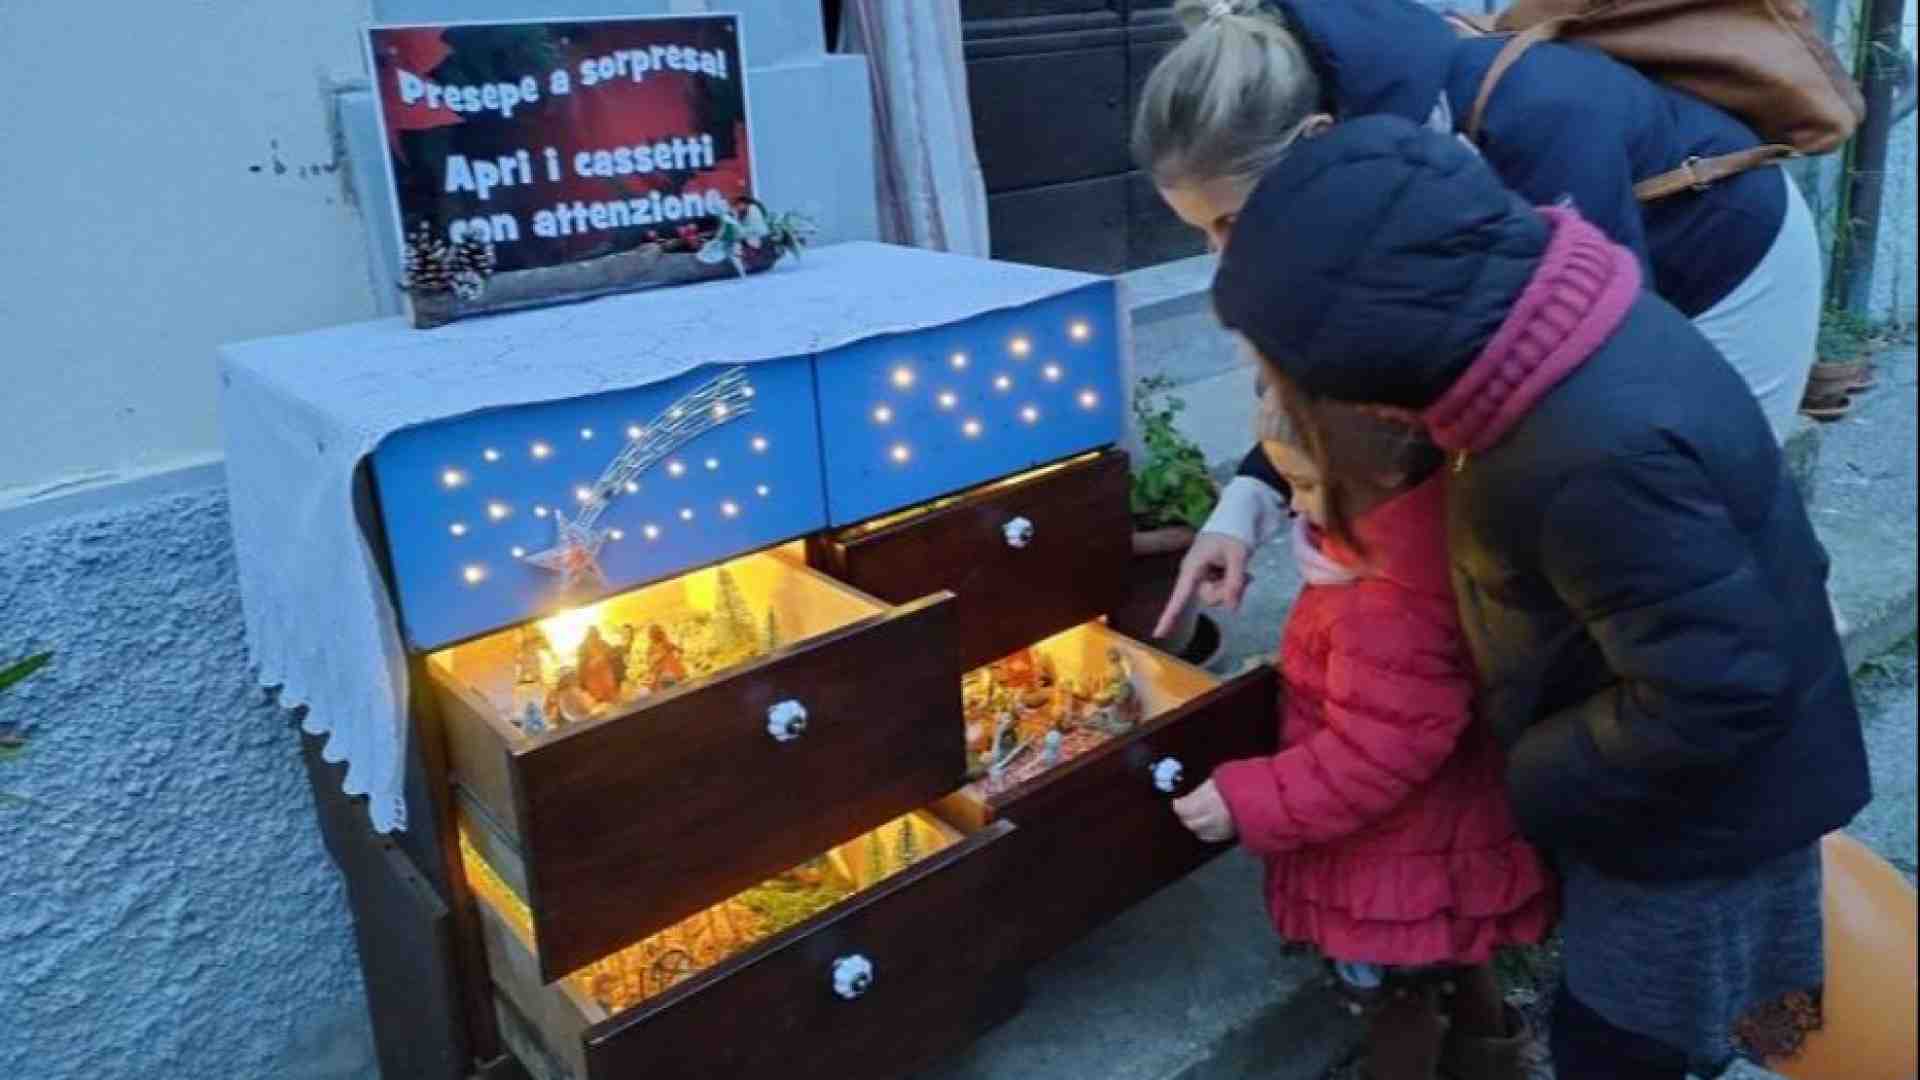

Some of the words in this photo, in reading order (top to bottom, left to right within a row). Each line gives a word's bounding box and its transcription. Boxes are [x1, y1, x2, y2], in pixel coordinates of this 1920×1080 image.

[397, 69, 539, 117] Presepe
[550, 69, 570, 97] a
[580, 45, 728, 86] sorpresa!
[445, 148, 534, 200] Apri
[544, 147, 560, 182] i
[574, 134, 714, 178] cassetti
[533, 187, 730, 238] attenzione
